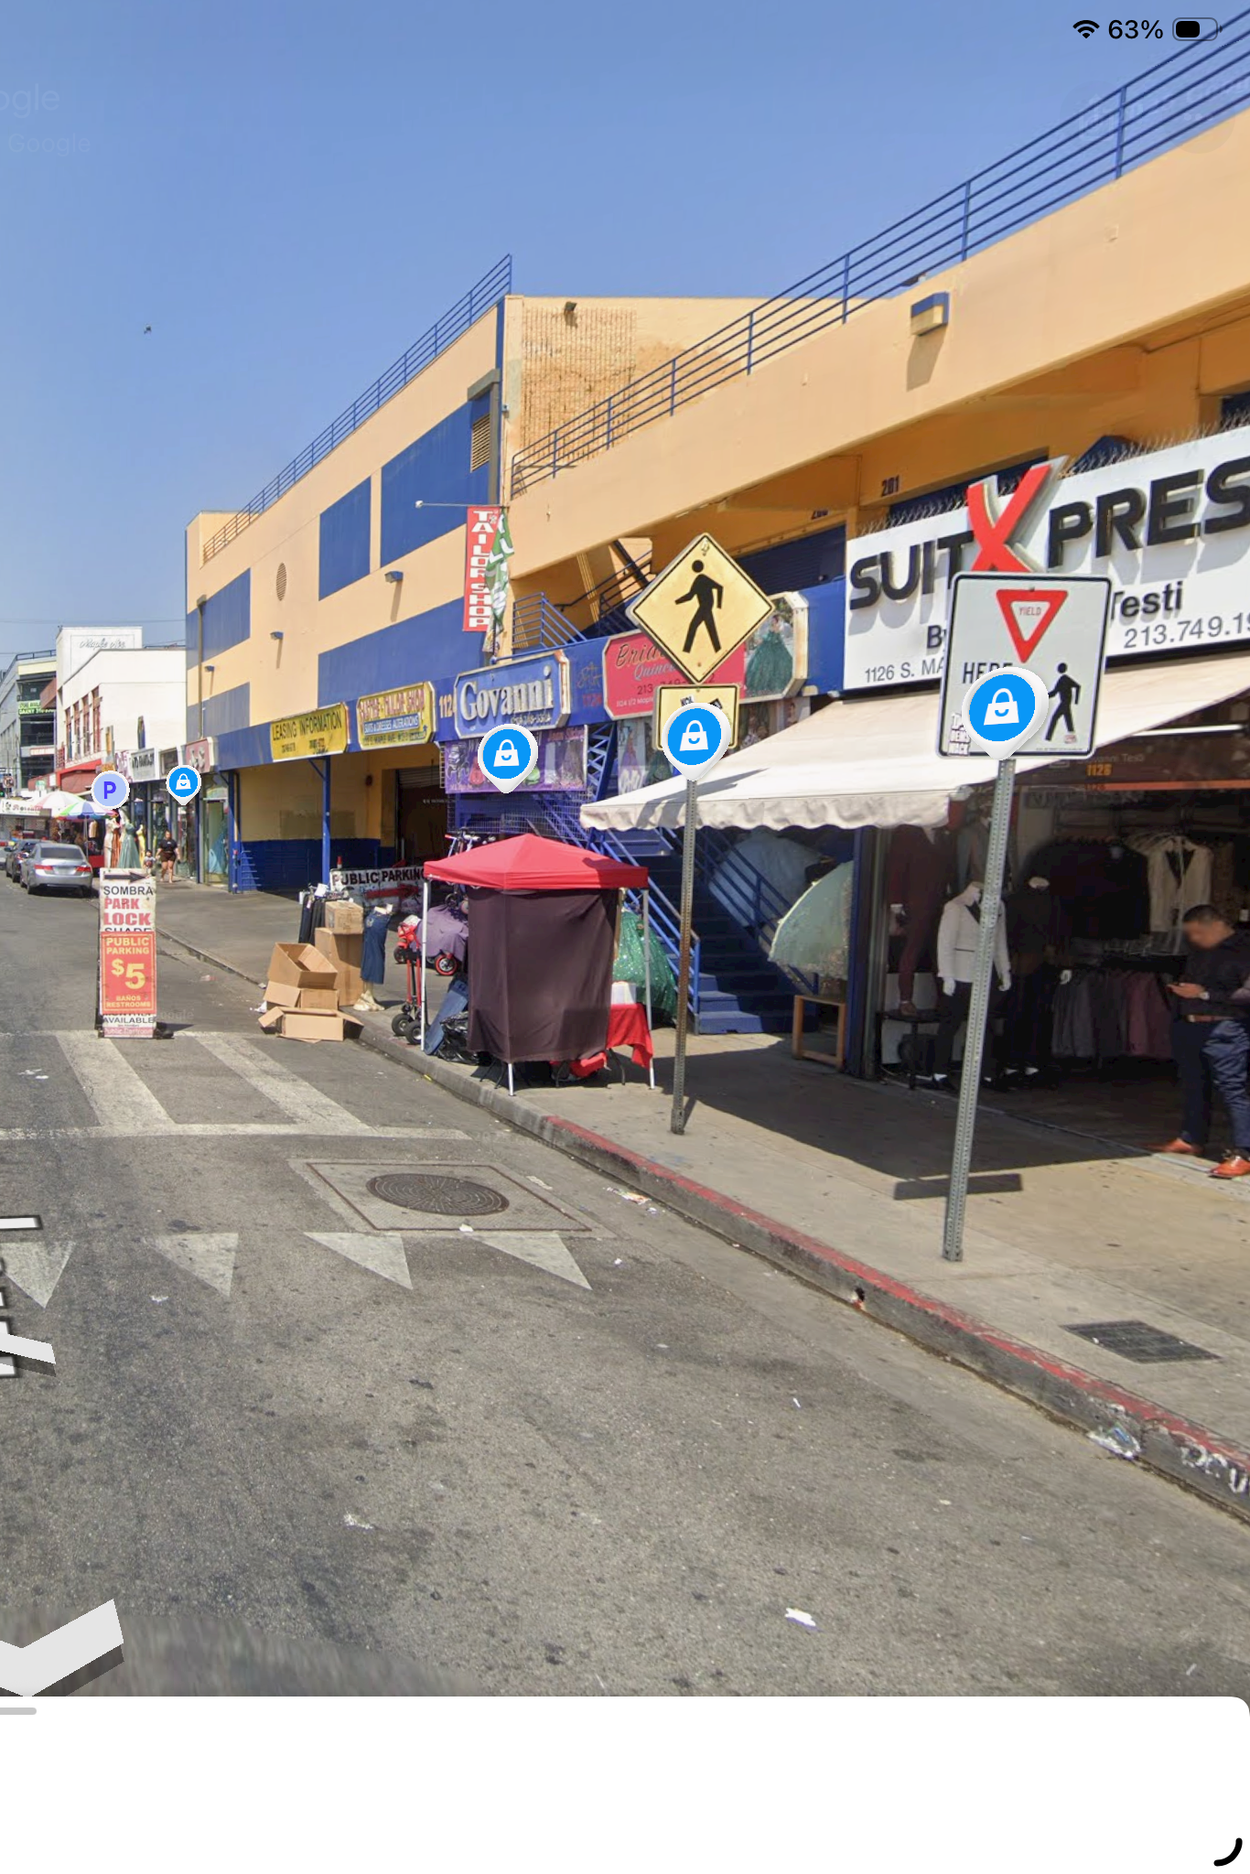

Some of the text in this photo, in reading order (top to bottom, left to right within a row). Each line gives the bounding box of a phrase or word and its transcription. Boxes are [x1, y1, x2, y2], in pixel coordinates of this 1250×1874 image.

[468, 582, 492, 628] SHOP
[1018, 606, 1043, 617] YIELD
[926, 624, 946, 650] B
[864, 663, 896, 683] 1126
[901, 661, 916, 679] S.
[962, 661, 1013, 685] HE
[459, 665, 554, 722] Govanni
[439, 693, 454, 719] 112
[272, 711, 343, 741] LEASING INFORMATION
[331, 870, 380, 887] PUBLIC
[103, 885, 154, 896] SOMBRA
[104, 897, 140, 910] PARK
[103, 912, 151, 926] LOCK
[106, 937, 150, 947] PUBLIC
[106, 946, 150, 955] PARKING
[111, 957, 146, 990] $5
[103, 1016, 155, 1025] AVAILABLE
